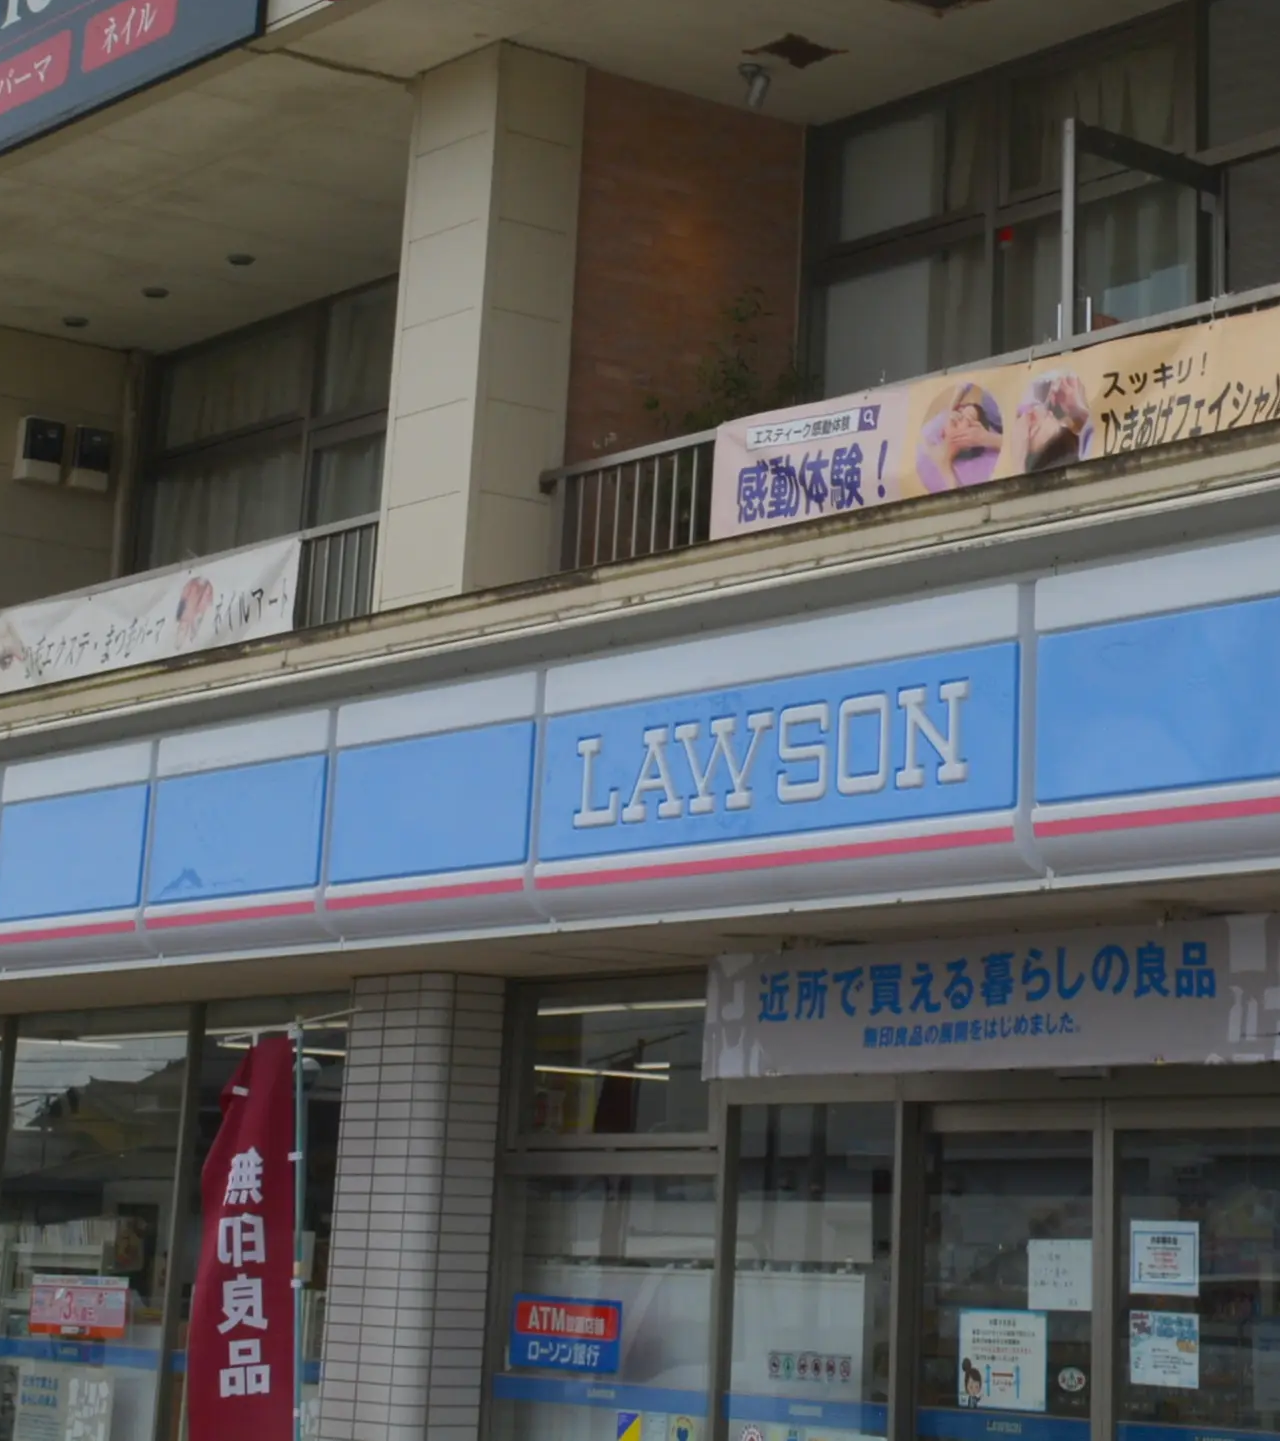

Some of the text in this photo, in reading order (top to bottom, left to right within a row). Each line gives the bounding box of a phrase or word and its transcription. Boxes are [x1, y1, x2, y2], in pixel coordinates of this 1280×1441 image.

[100, 0, 158, 55] ネイル
[753, 415, 852, 445] エスティーク感動体験
[571, 676, 972, 831] LAWSON
[755, 939, 1218, 1025] 近所で買える暮らしの良品
[527, 1340, 601, 1367] ローソン銀行
